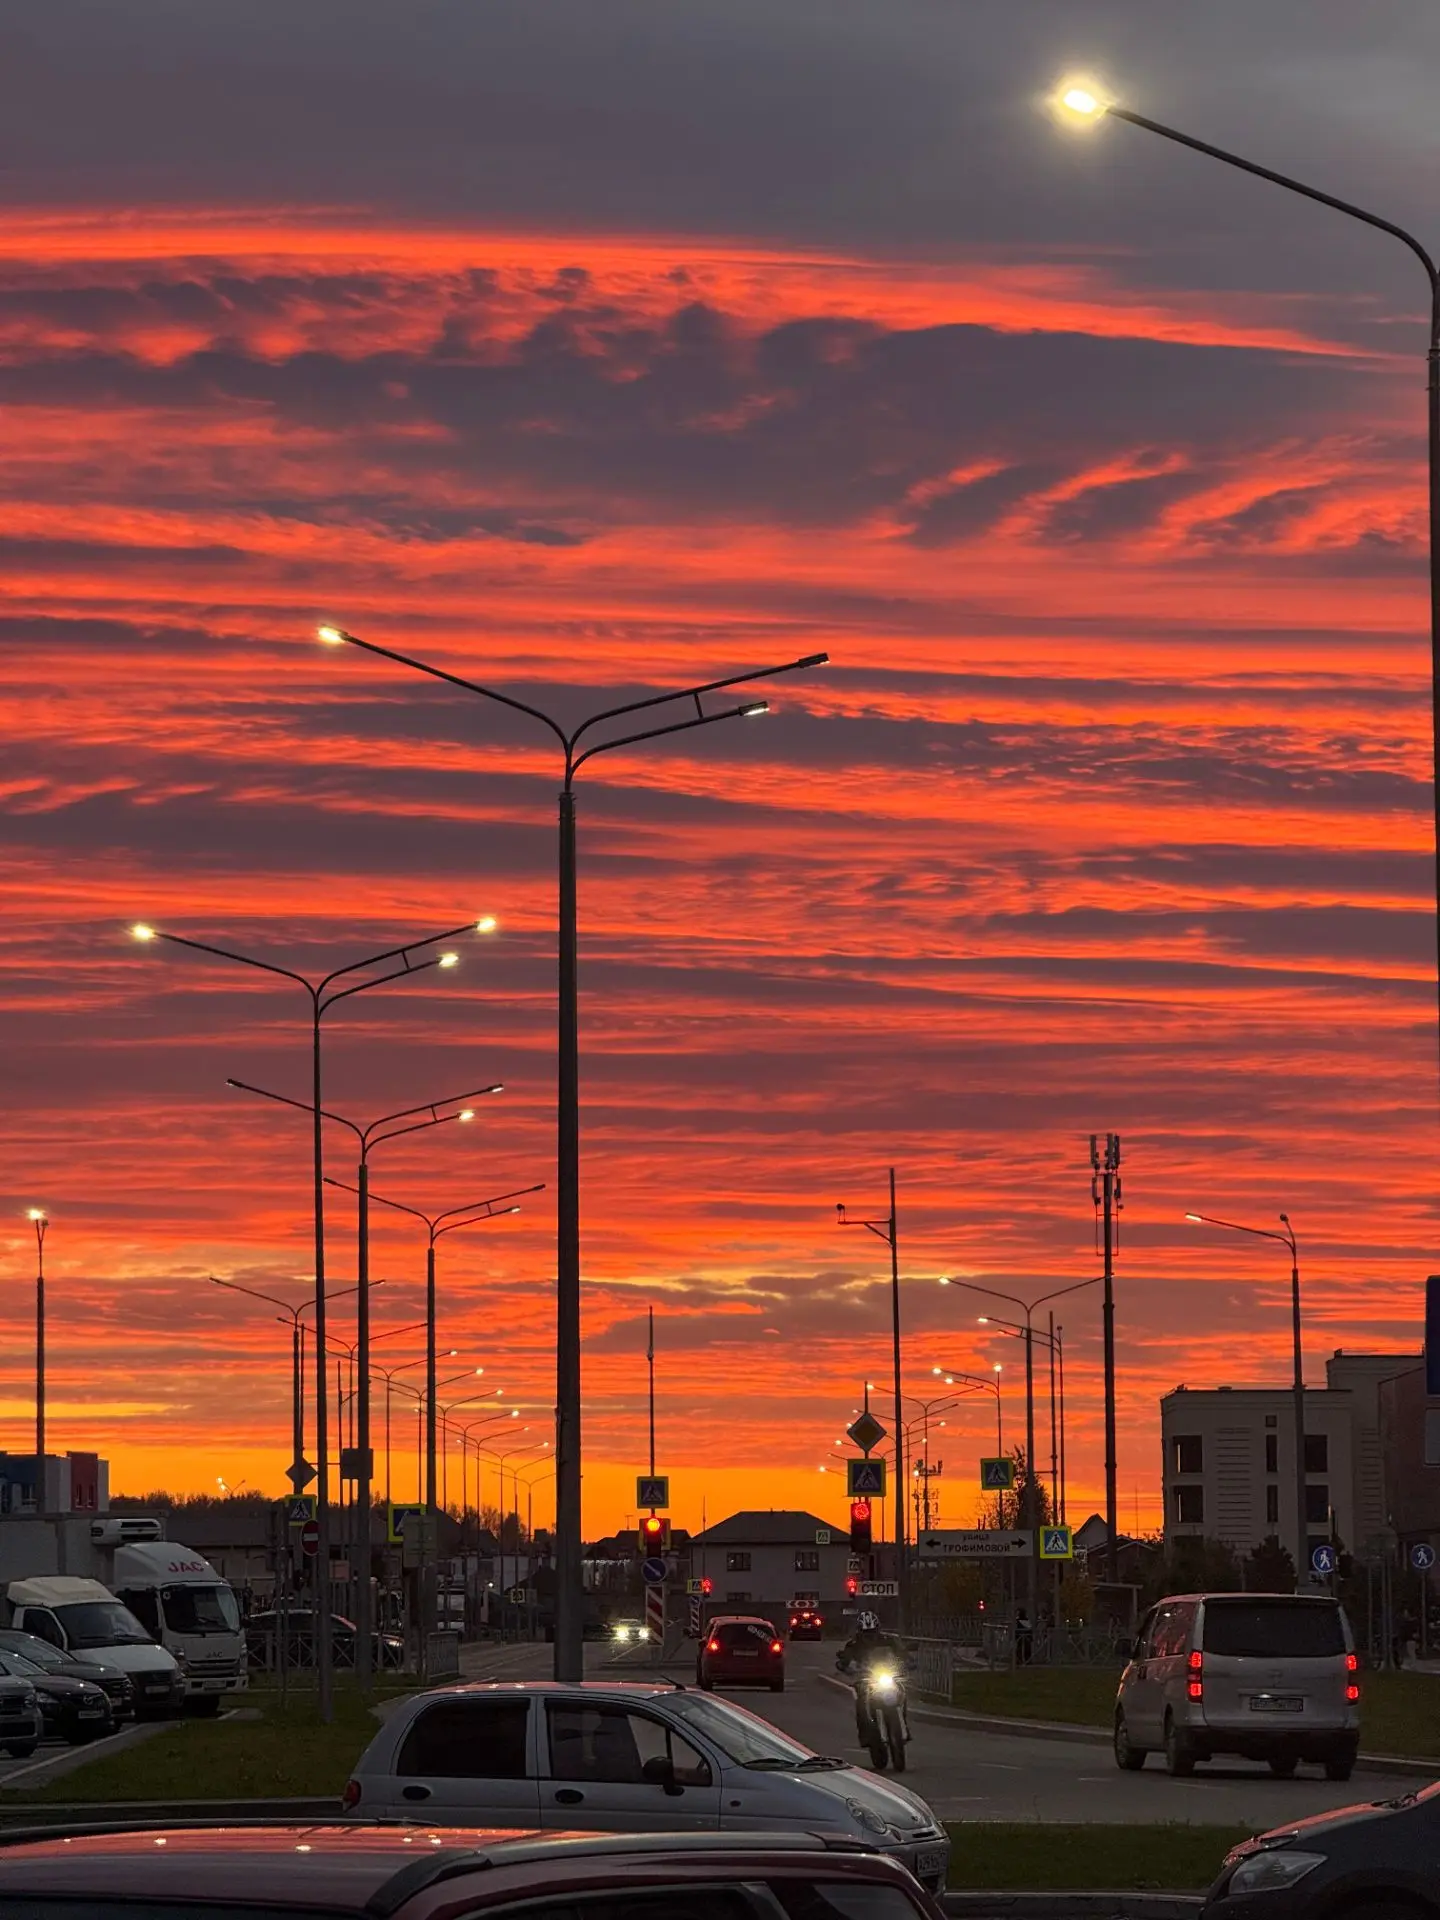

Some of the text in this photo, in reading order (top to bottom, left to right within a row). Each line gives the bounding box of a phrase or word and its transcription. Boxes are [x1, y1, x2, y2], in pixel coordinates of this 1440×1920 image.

[944, 1544, 1011, 1553] ТРОФИМОВОЙ
[168, 1561, 204, 1572] JAC
[861, 1583, 894, 1594] СТОП
